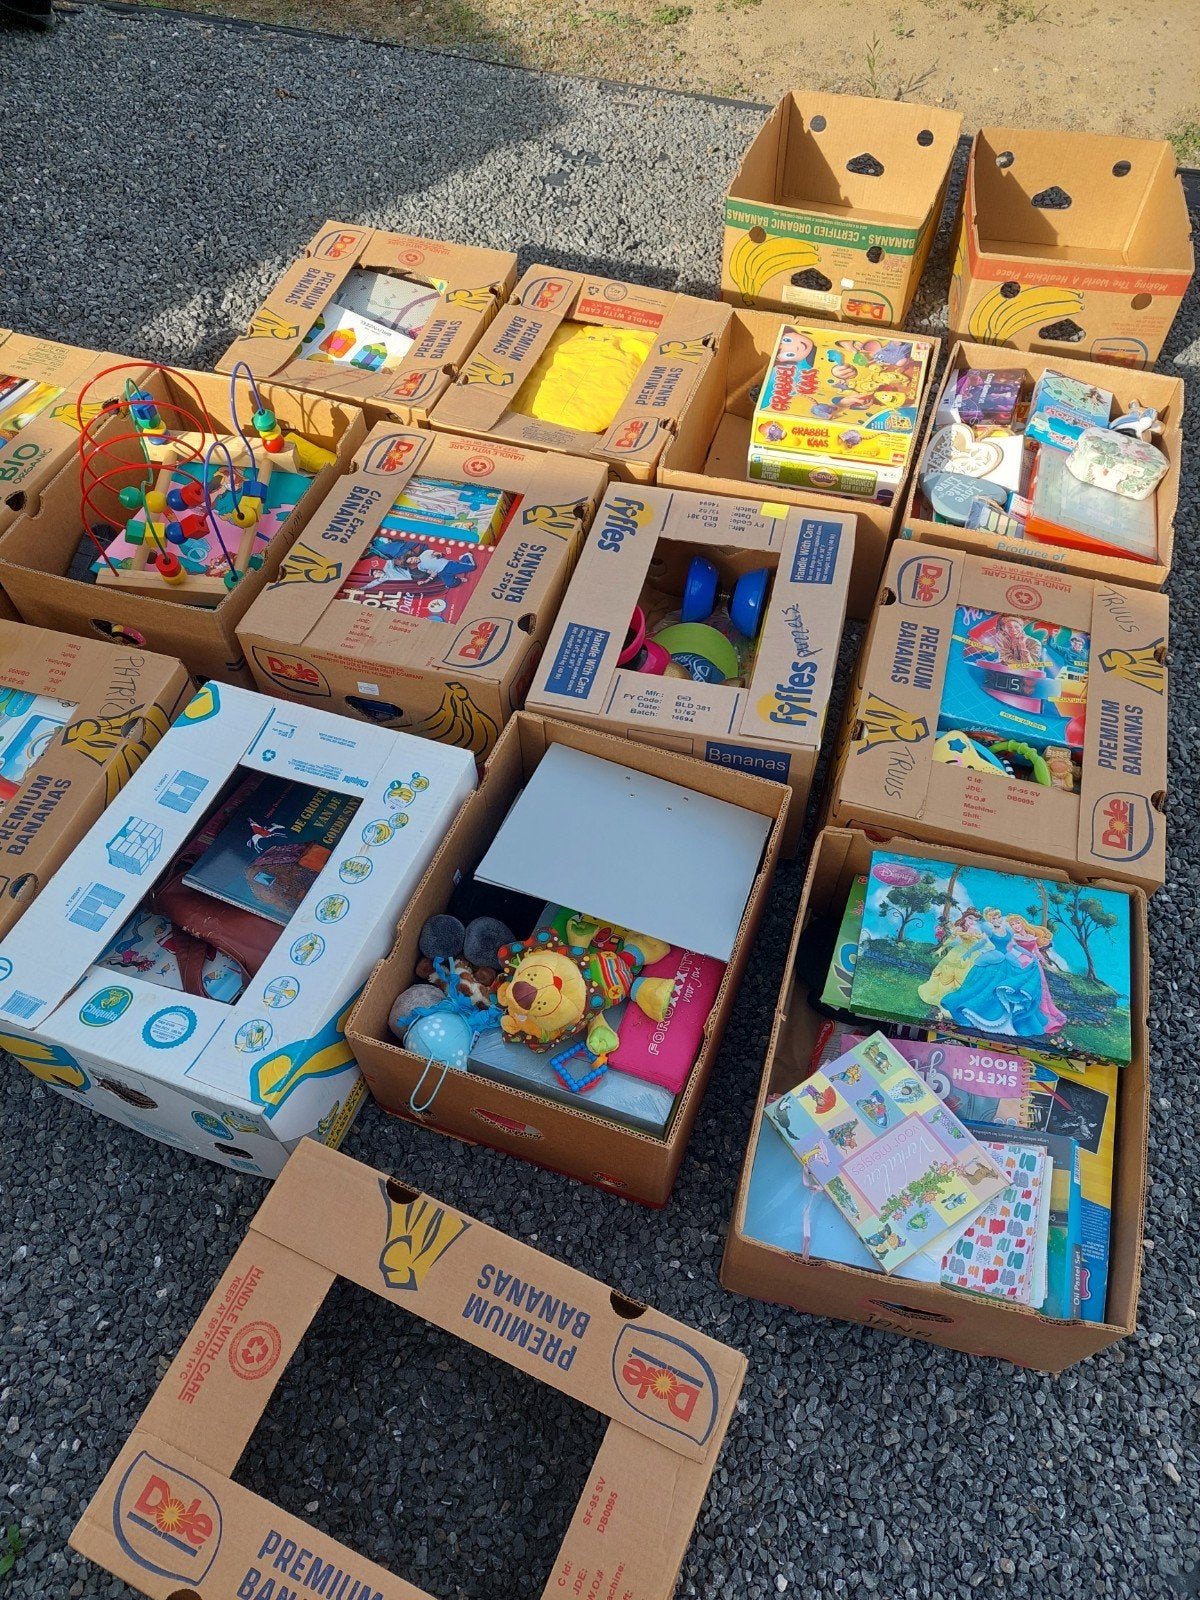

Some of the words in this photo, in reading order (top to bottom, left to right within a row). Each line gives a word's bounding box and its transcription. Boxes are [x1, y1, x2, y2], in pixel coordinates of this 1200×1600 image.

[727, 208, 770, 226] BANANAS
[771, 218, 812, 234] ORGANIC
[328, 234, 356, 259] Dole
[814, 226, 859, 242] CERTIFIED
[868, 234, 916, 248] BANANAS
[286, 268, 321, 306] BANANAS
[1024, 272, 1068, 282] Healthier
[1072, 276, 1080, 284] A
[1083, 276, 1110, 287] World
[1113, 278, 1130, 288] The
[1134, 281, 1168, 292] Making
[300, 272, 335, 310] PREMIUM
[536, 282, 564, 308] Dole
[580, 306, 600, 314] CARE
[603, 310, 625, 320] WITH
[628, 314, 660, 326] HANDLE
[846, 301, 885, 320] Dole
[414, 319, 448, 358] PREMIUM
[430, 320, 462, 359] BANANAS
[493, 316, 528, 356] BANANAS
[508, 322, 543, 362] PREMIUM
[394, 372, 424, 398] Dole
[634, 366, 667, 406] PREMIUM
[652, 367, 684, 408] BANANAS
[449, 442, 471, 451] CARE
[615, 420, 644, 448] Dole
[807, 438, 829, 448] KAAS
[0, 444, 40, 481] BIO
[381, 440, 414, 472] Dole
[472, 446, 492, 455] WITH
[494, 450, 526, 462] HANDLE
[12, 448, 52, 484] ORGANIC
[322, 486, 370, 542] BANANAS
[358, 490, 382, 514] Class
[733, 506, 758, 514] Batch:
[340, 517, 364, 544] Extra
[598, 496, 646, 553] fyffes
[730, 519, 753, 527] Code:
[803, 523, 815, 539] Care
[799, 539, 811, 556] With
[996, 542, 1048, 560] Produce
[1052, 553, 1067, 562] of
[491, 572, 514, 600] Class
[506, 542, 530, 569] Extra
[504, 544, 548, 603] BANANAS
[795, 556, 808, 581] Handle
[982, 569, 1007, 578] CARE
[1009, 574, 1032, 584] WITH
[916, 563, 943, 604] Dole
[1035, 580, 1071, 593] HANDLE
[398, 592, 415, 614] Date
[1098, 586, 1140, 634] TRUUS
[458, 620, 495, 662] Dole
[588, 632, 605, 657] Handle
[891, 620, 918, 686] BANANAS
[267, 656, 319, 683] Dole
[582, 659, 596, 675] With
[913, 626, 940, 690] PREMIUM
[575, 677, 589, 693] Care
[646, 690, 664, 698] Mfr.:
[769, 662, 818, 726] fyffes
[630, 708, 657, 717] Batch:
[637, 696, 662, 704] Code:
[638, 702, 660, 710] Date:
[1098, 699, 1120, 771] PREMIUM
[1122, 704, 1144, 776] BANANAS
[708, 748, 786, 772] Bananas
[884, 746, 915, 800] TRUUS
[966, 785, 982, 793] JDE:
[6, 778, 72, 856] BANANAS
[313, 808, 333, 827] VAN
[328, 796, 341, 810] DE
[963, 812, 981, 820] Shift:
[964, 803, 996, 814] Machine:
[291, 818, 307, 833] DE
[323, 815, 348, 844] GOEDE
[962, 820, 980, 829] Date:
[1102, 799, 1129, 850] Dole
[880, 867, 915, 885] Disney
[683, 983, 695, 1003] voor
[691, 967, 702, 988] jou
[82, 1003, 120, 1021] Chiquita
[969, 1055, 1018, 1072] BOOK
[954, 1067, 1017, 1087] SKETCH
[895, 1125, 920, 1147] voor
[852, 1144, 892, 1175] meisjes
[865, 1136, 935, 1197] Verhalen
[225, 1276, 242, 1303] KEEP
[1074, 1266, 1082, 1291] Pastel
[227, 1267, 264, 1324] HANDLE
[476, 1263, 591, 1339] BANANAS
[1074, 1291, 1082, 1307] Oil
[218, 1303, 226, 1317] AT
[206, 1325, 233, 1361] WITH
[462, 1292, 578, 1372] PREMIUM
[192, 1340, 205, 1355] OR
[183, 1362, 210, 1404] CARE
[622, 1358, 700, 1422] Dole
[134, 1474, 213, 1545] Dole
[582, 1494, 600, 1526] SF-95
[595, 1476, 606, 1492] SV
[597, 1491, 618, 1534] DB0095
[257, 1530, 384, 1600] PREMIUM
[558, 1578, 566, 1587] C
[562, 1560, 572, 1576] Id:
[573, 1568, 587, 1596] JDE:
